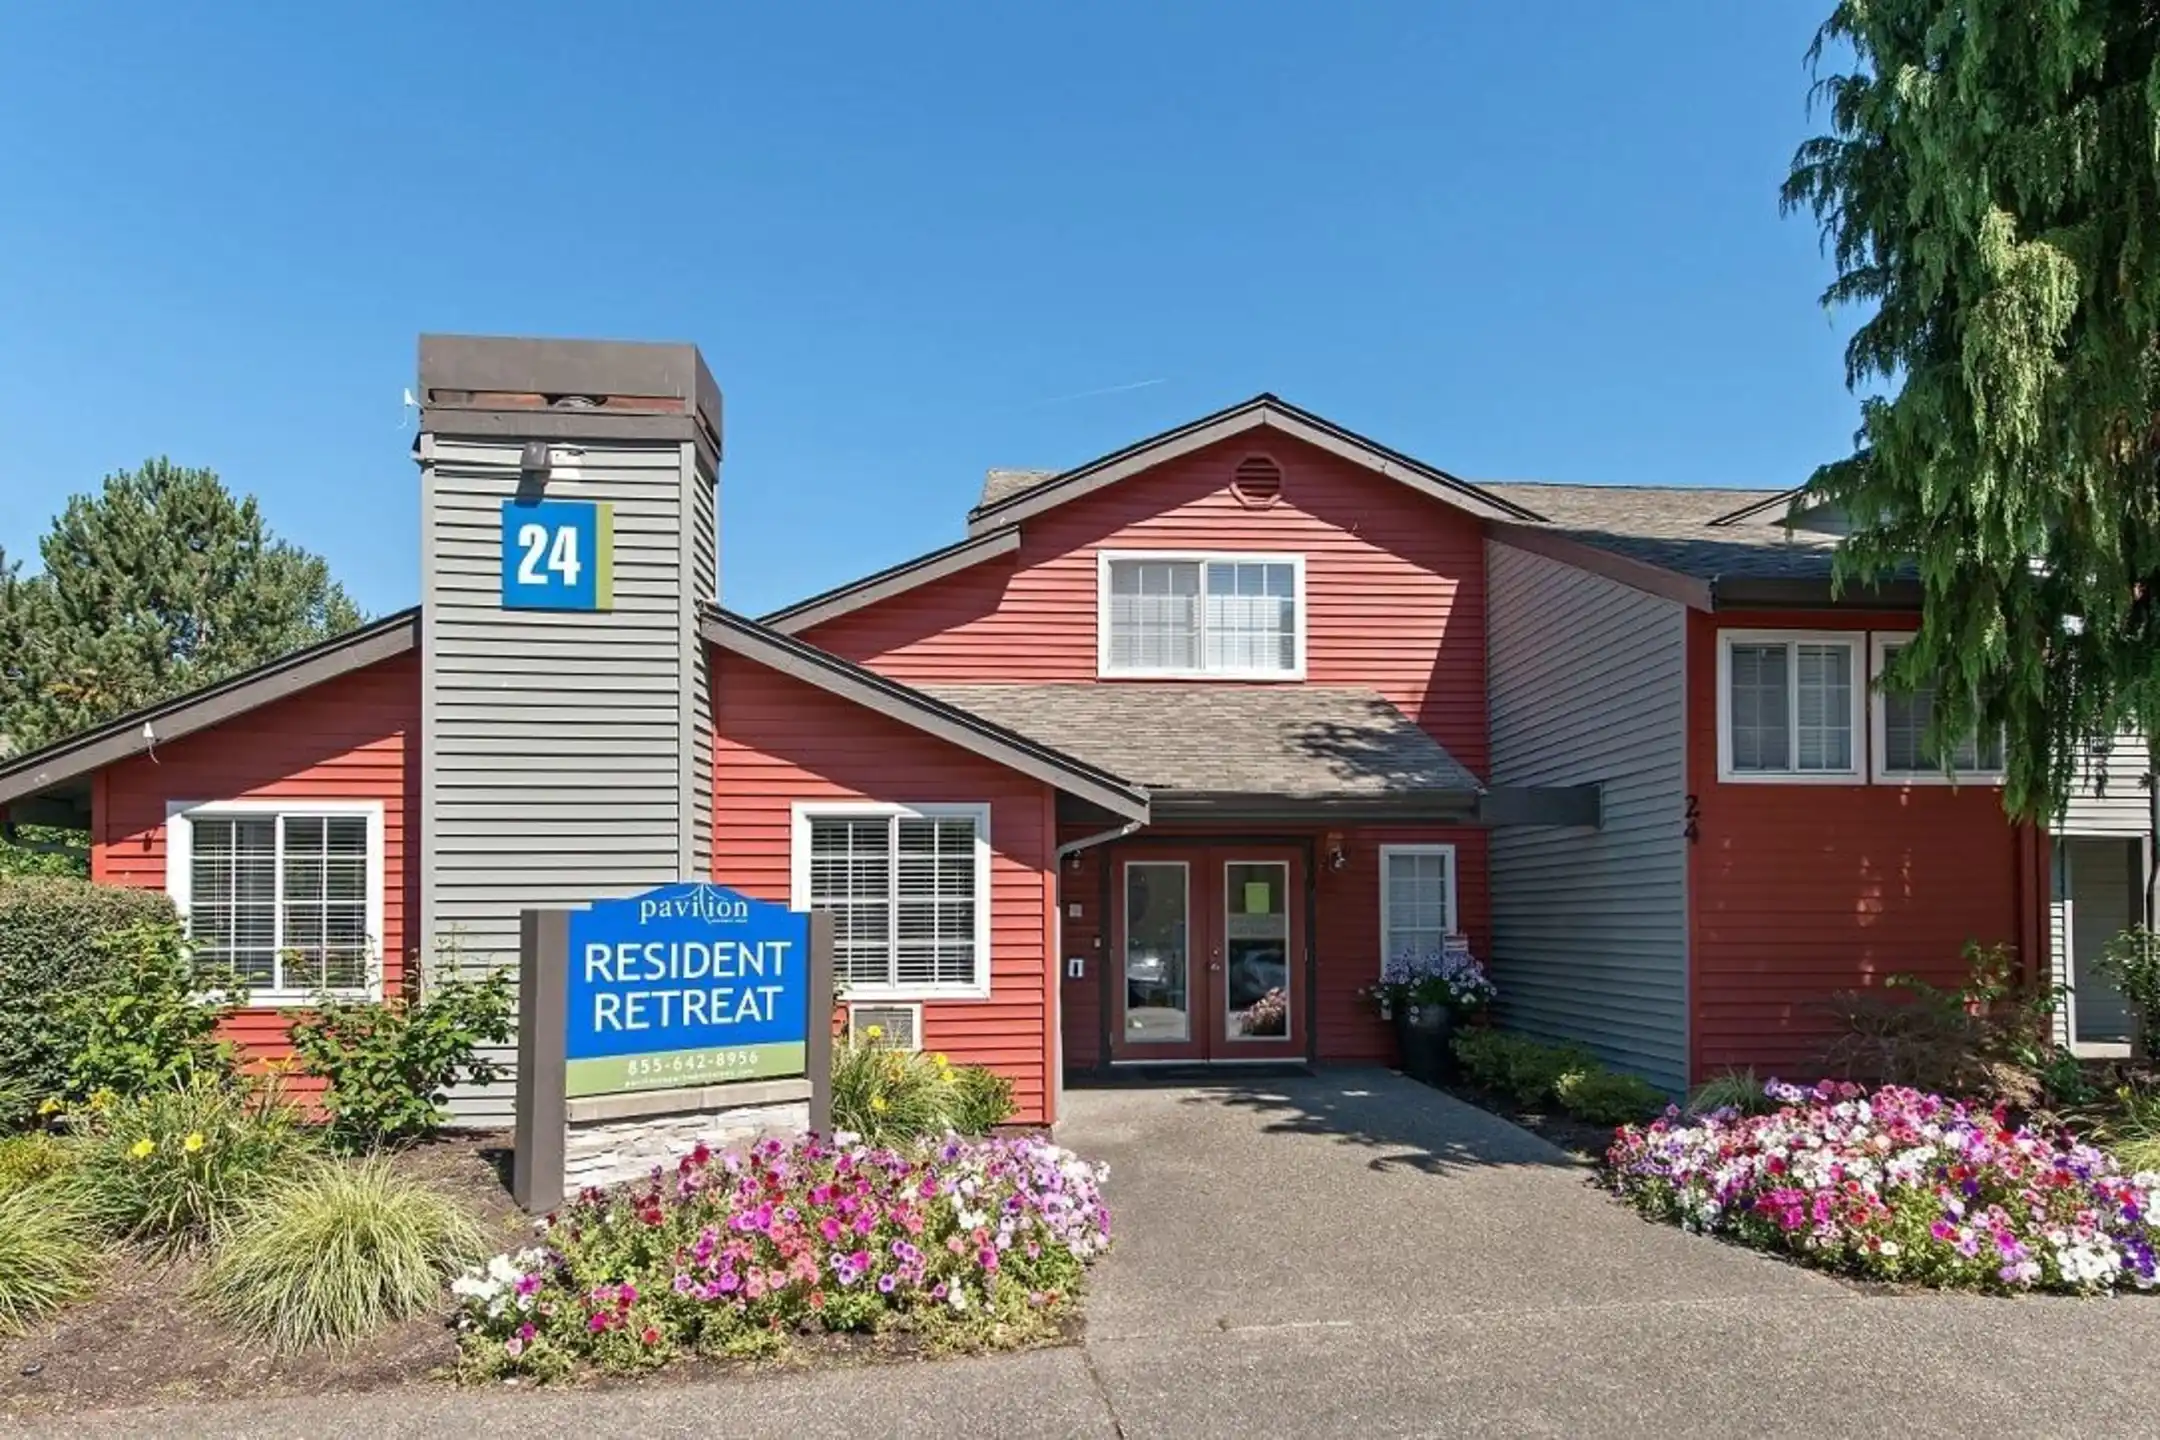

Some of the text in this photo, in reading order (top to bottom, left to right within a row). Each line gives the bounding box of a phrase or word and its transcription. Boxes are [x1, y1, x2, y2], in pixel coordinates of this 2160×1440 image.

[518, 523, 581, 586] 24
[639, 885, 748, 925] pavilion
[584, 941, 792, 983] RESIDENT
[594, 985, 784, 1032] RETREAT
[627, 1050, 759, 1077] 855-642-8956
